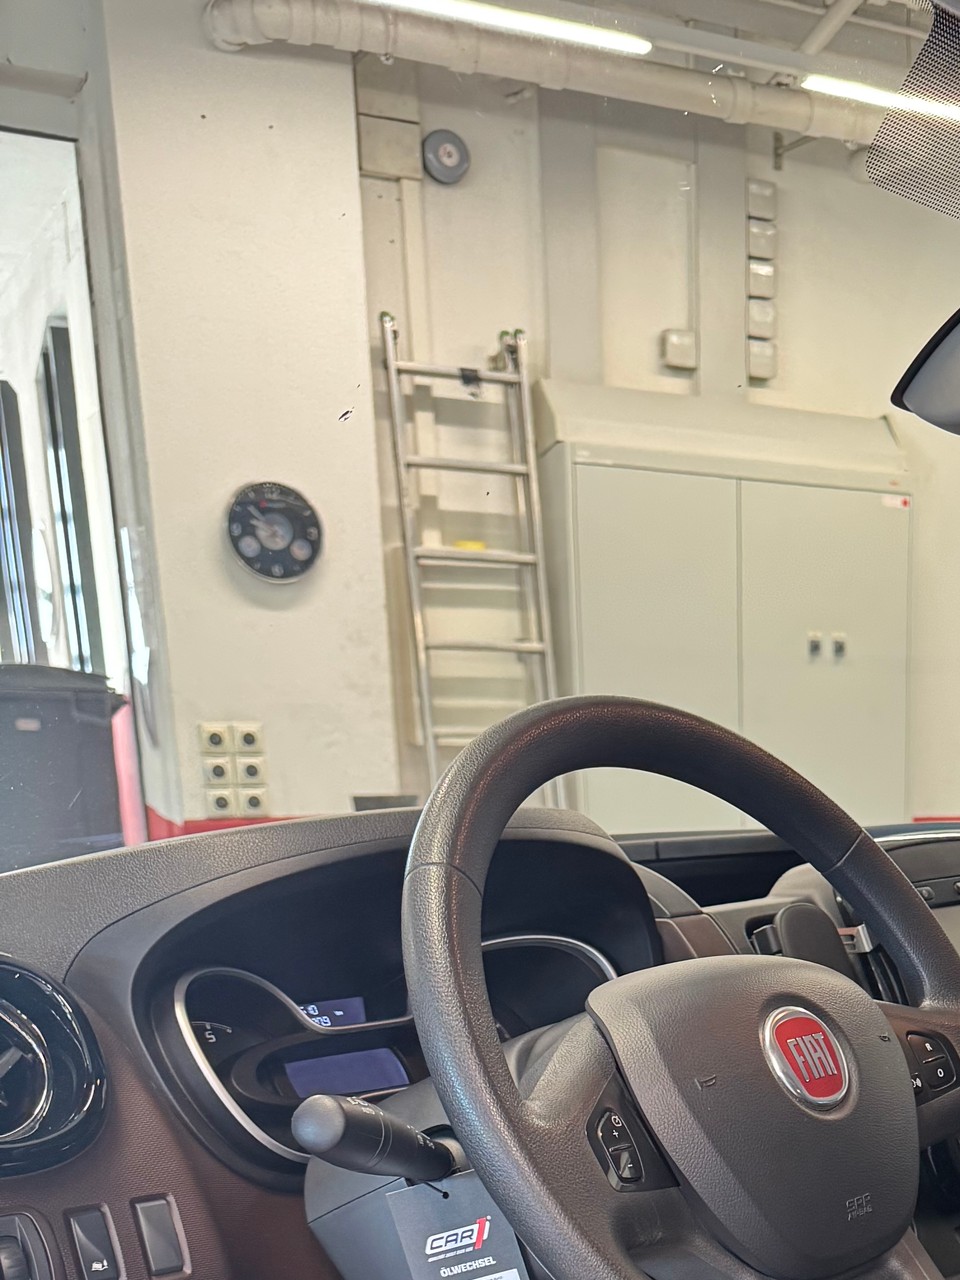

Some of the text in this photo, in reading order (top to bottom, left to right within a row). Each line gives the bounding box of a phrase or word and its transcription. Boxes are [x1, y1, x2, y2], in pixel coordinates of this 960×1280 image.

[787, 1032, 838, 1083] FIAT
[925, 1043, 933, 1052] R
[440, 1256, 497, 1278] ÖLWECHSEL
